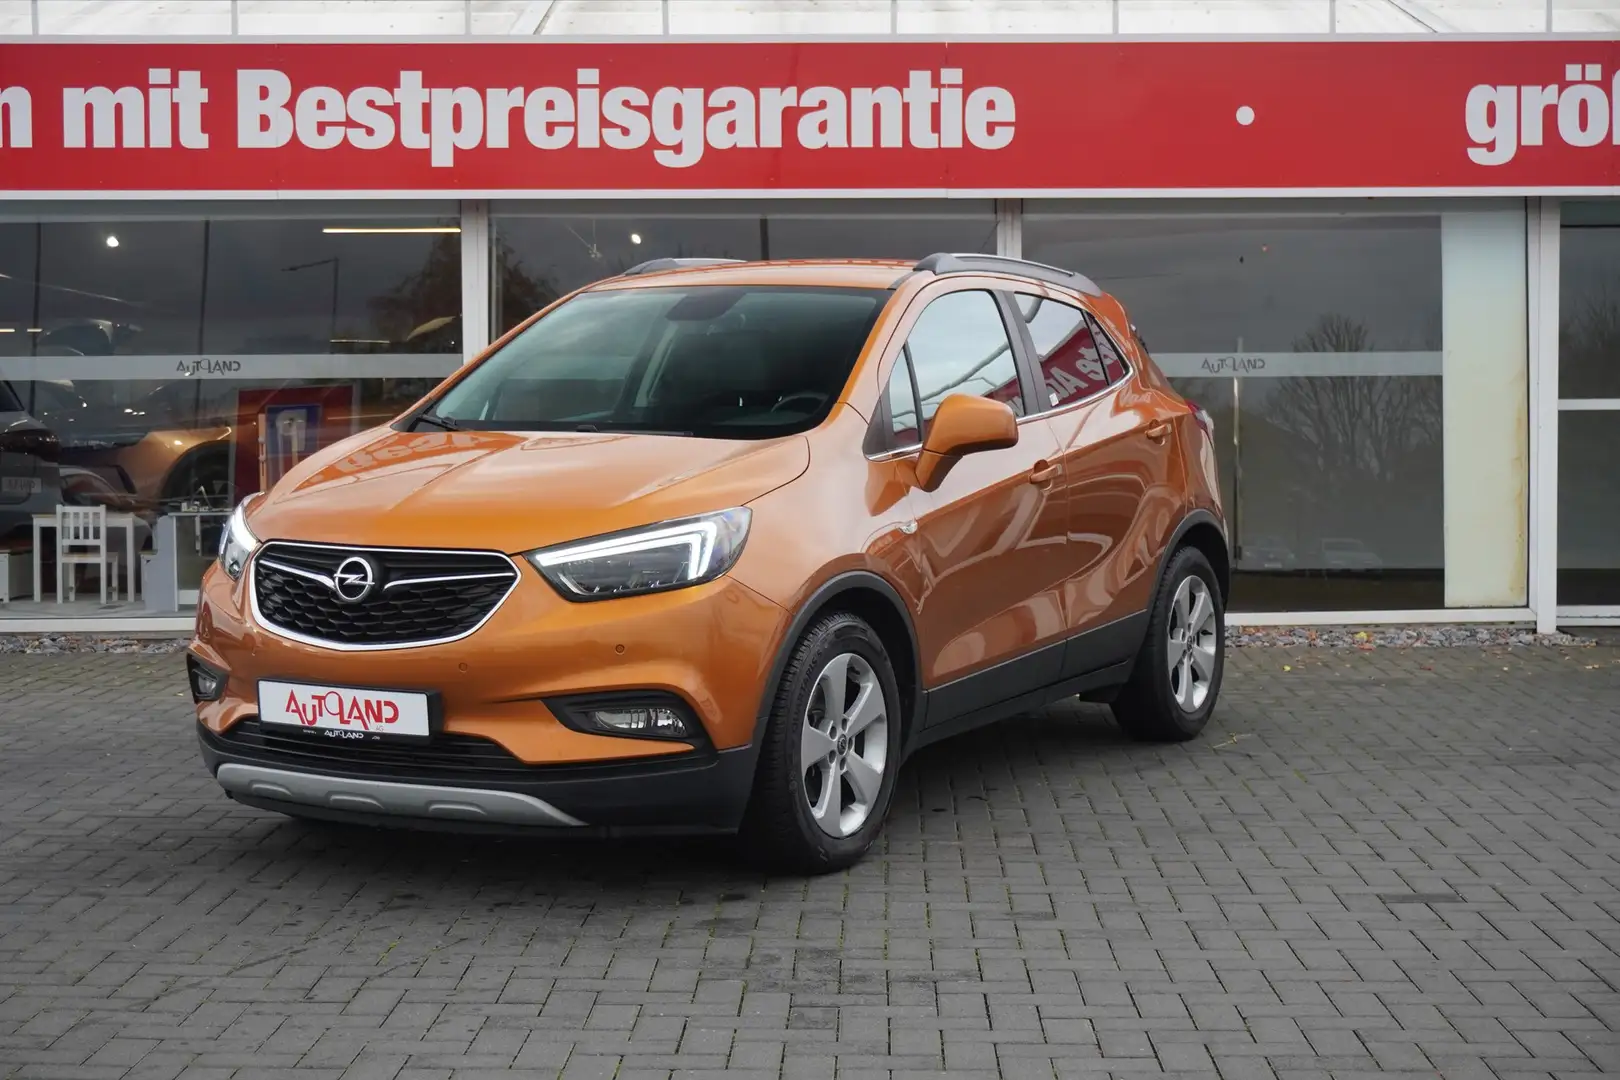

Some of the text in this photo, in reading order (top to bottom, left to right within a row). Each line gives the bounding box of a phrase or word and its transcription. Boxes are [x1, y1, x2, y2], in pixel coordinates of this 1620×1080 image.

[62, 68, 209, 149] mit
[236, 68, 1016, 168] Bestpreisgarantie
[1465, 63, 1620, 166] grö
[176, 358, 241, 376] AUTOLAND
[1201, 356, 1265, 374] AUTOLAND
[285, 689, 399, 731] AUTOLAND
[324, 729, 364, 739] AUTOLAND
